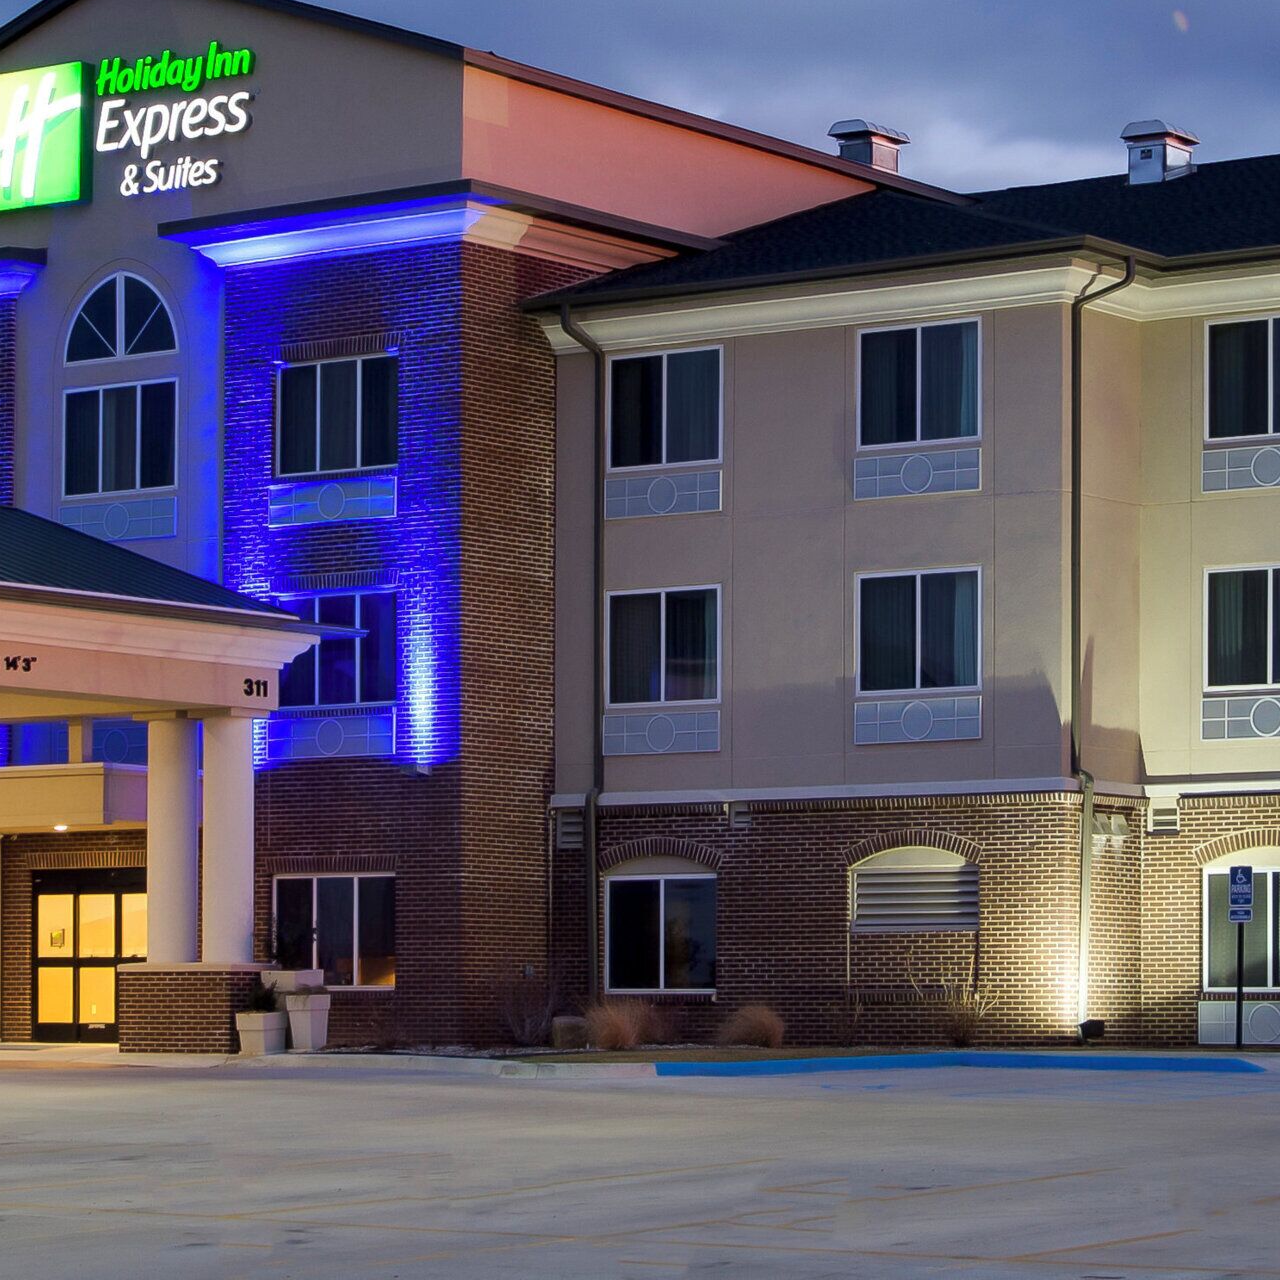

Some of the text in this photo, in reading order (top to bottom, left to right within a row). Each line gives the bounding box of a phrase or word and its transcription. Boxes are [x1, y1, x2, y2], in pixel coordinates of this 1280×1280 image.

[96, 40, 251, 96] Holiday Inn
[95, 90, 250, 159] Express
[120, 156, 219, 197] & Suites
[243, 678, 269, 698] 311
